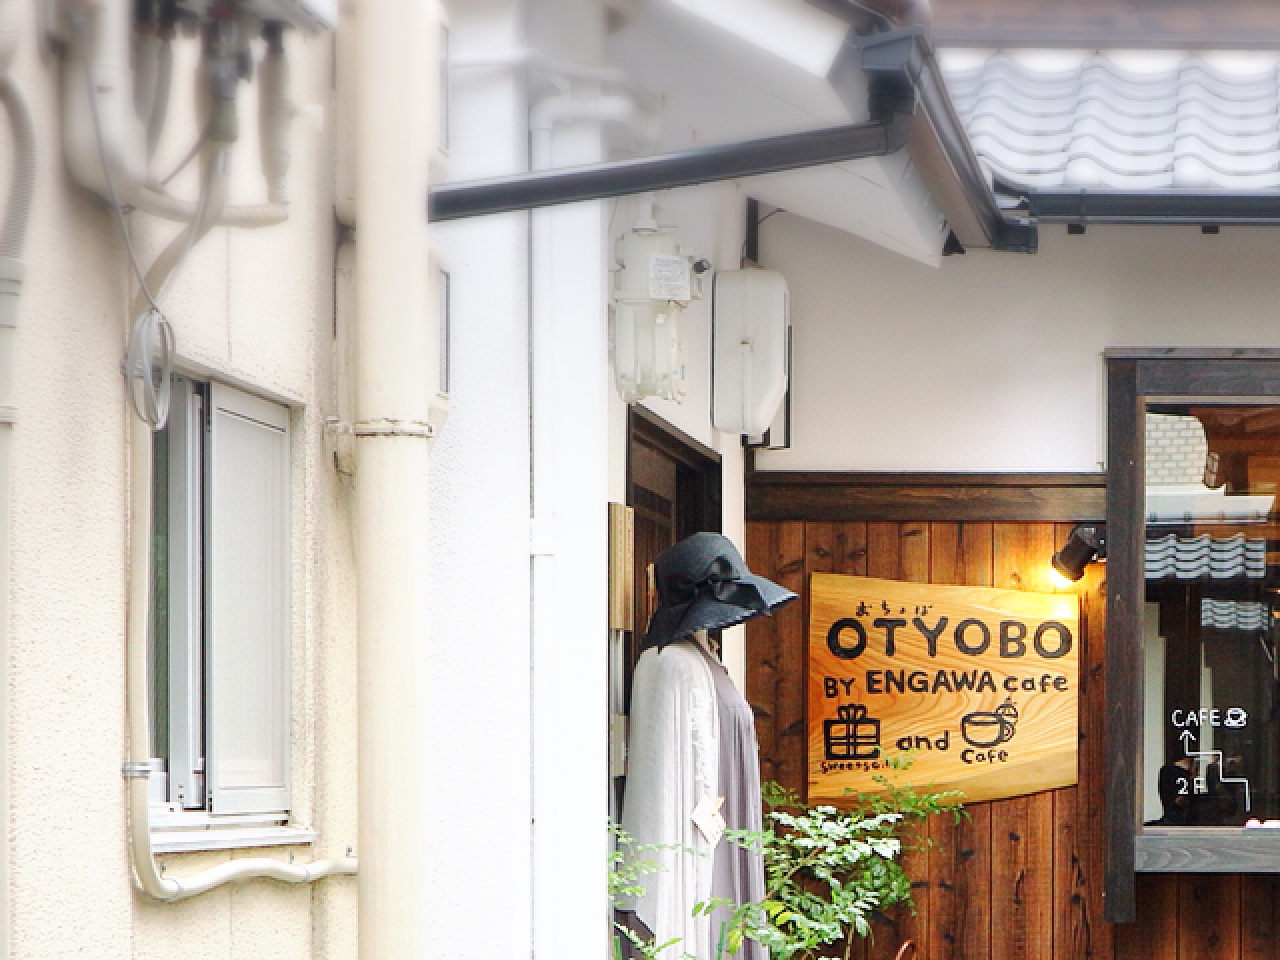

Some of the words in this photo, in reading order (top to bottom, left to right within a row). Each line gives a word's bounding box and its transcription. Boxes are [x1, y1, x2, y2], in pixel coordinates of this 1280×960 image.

[826, 617, 1073, 660] OTYOBO
[824, 677, 856, 698] BY
[866, 669, 997, 694] ENGAWA
[1003, 674, 1068, 692] cafe
[1171, 708, 1221, 728] CAFE
[896, 730, 950, 751] and
[960, 748, 1009, 765] Cafe
[1175, 777, 1205, 795] 2F
